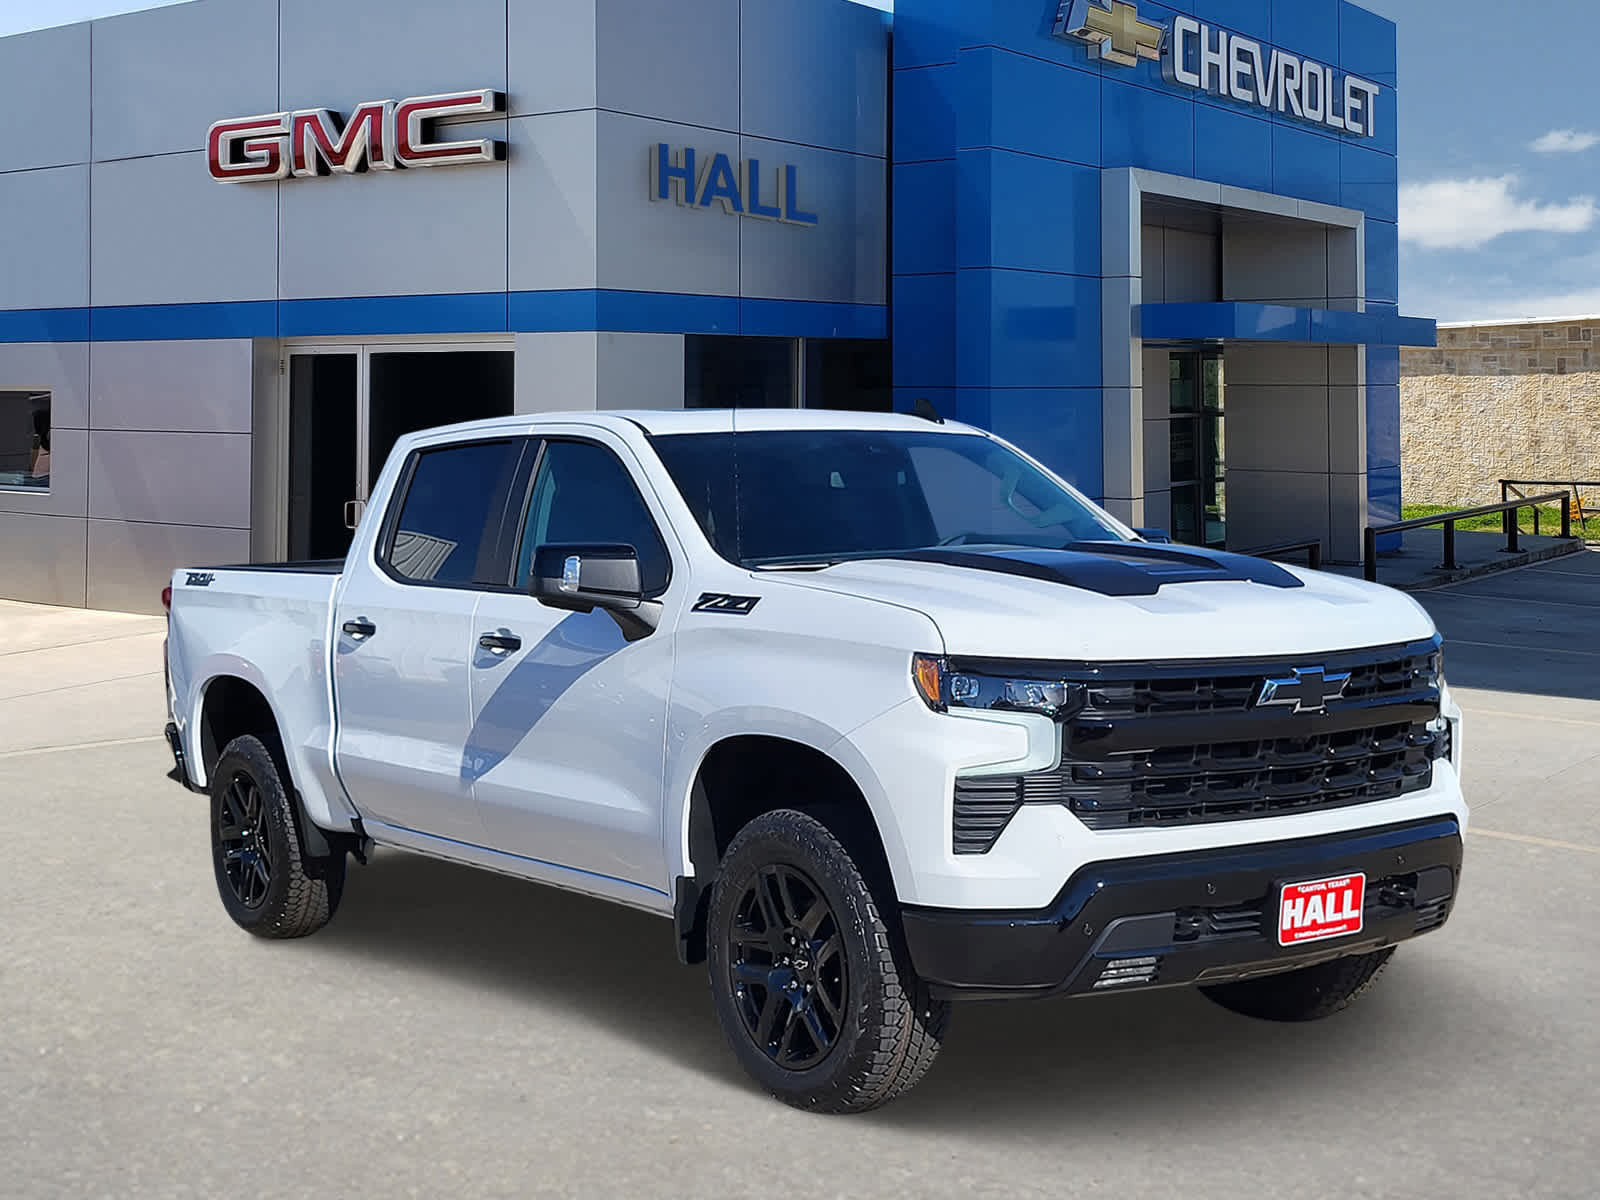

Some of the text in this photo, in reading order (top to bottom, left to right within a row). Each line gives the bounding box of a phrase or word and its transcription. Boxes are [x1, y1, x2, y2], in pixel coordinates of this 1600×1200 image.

[1173, 15, 1380, 137] CHEVROLET
[206, 88, 507, 184] GMC
[653, 143, 818, 226] HALL
[1282, 889, 1360, 930] HALL
